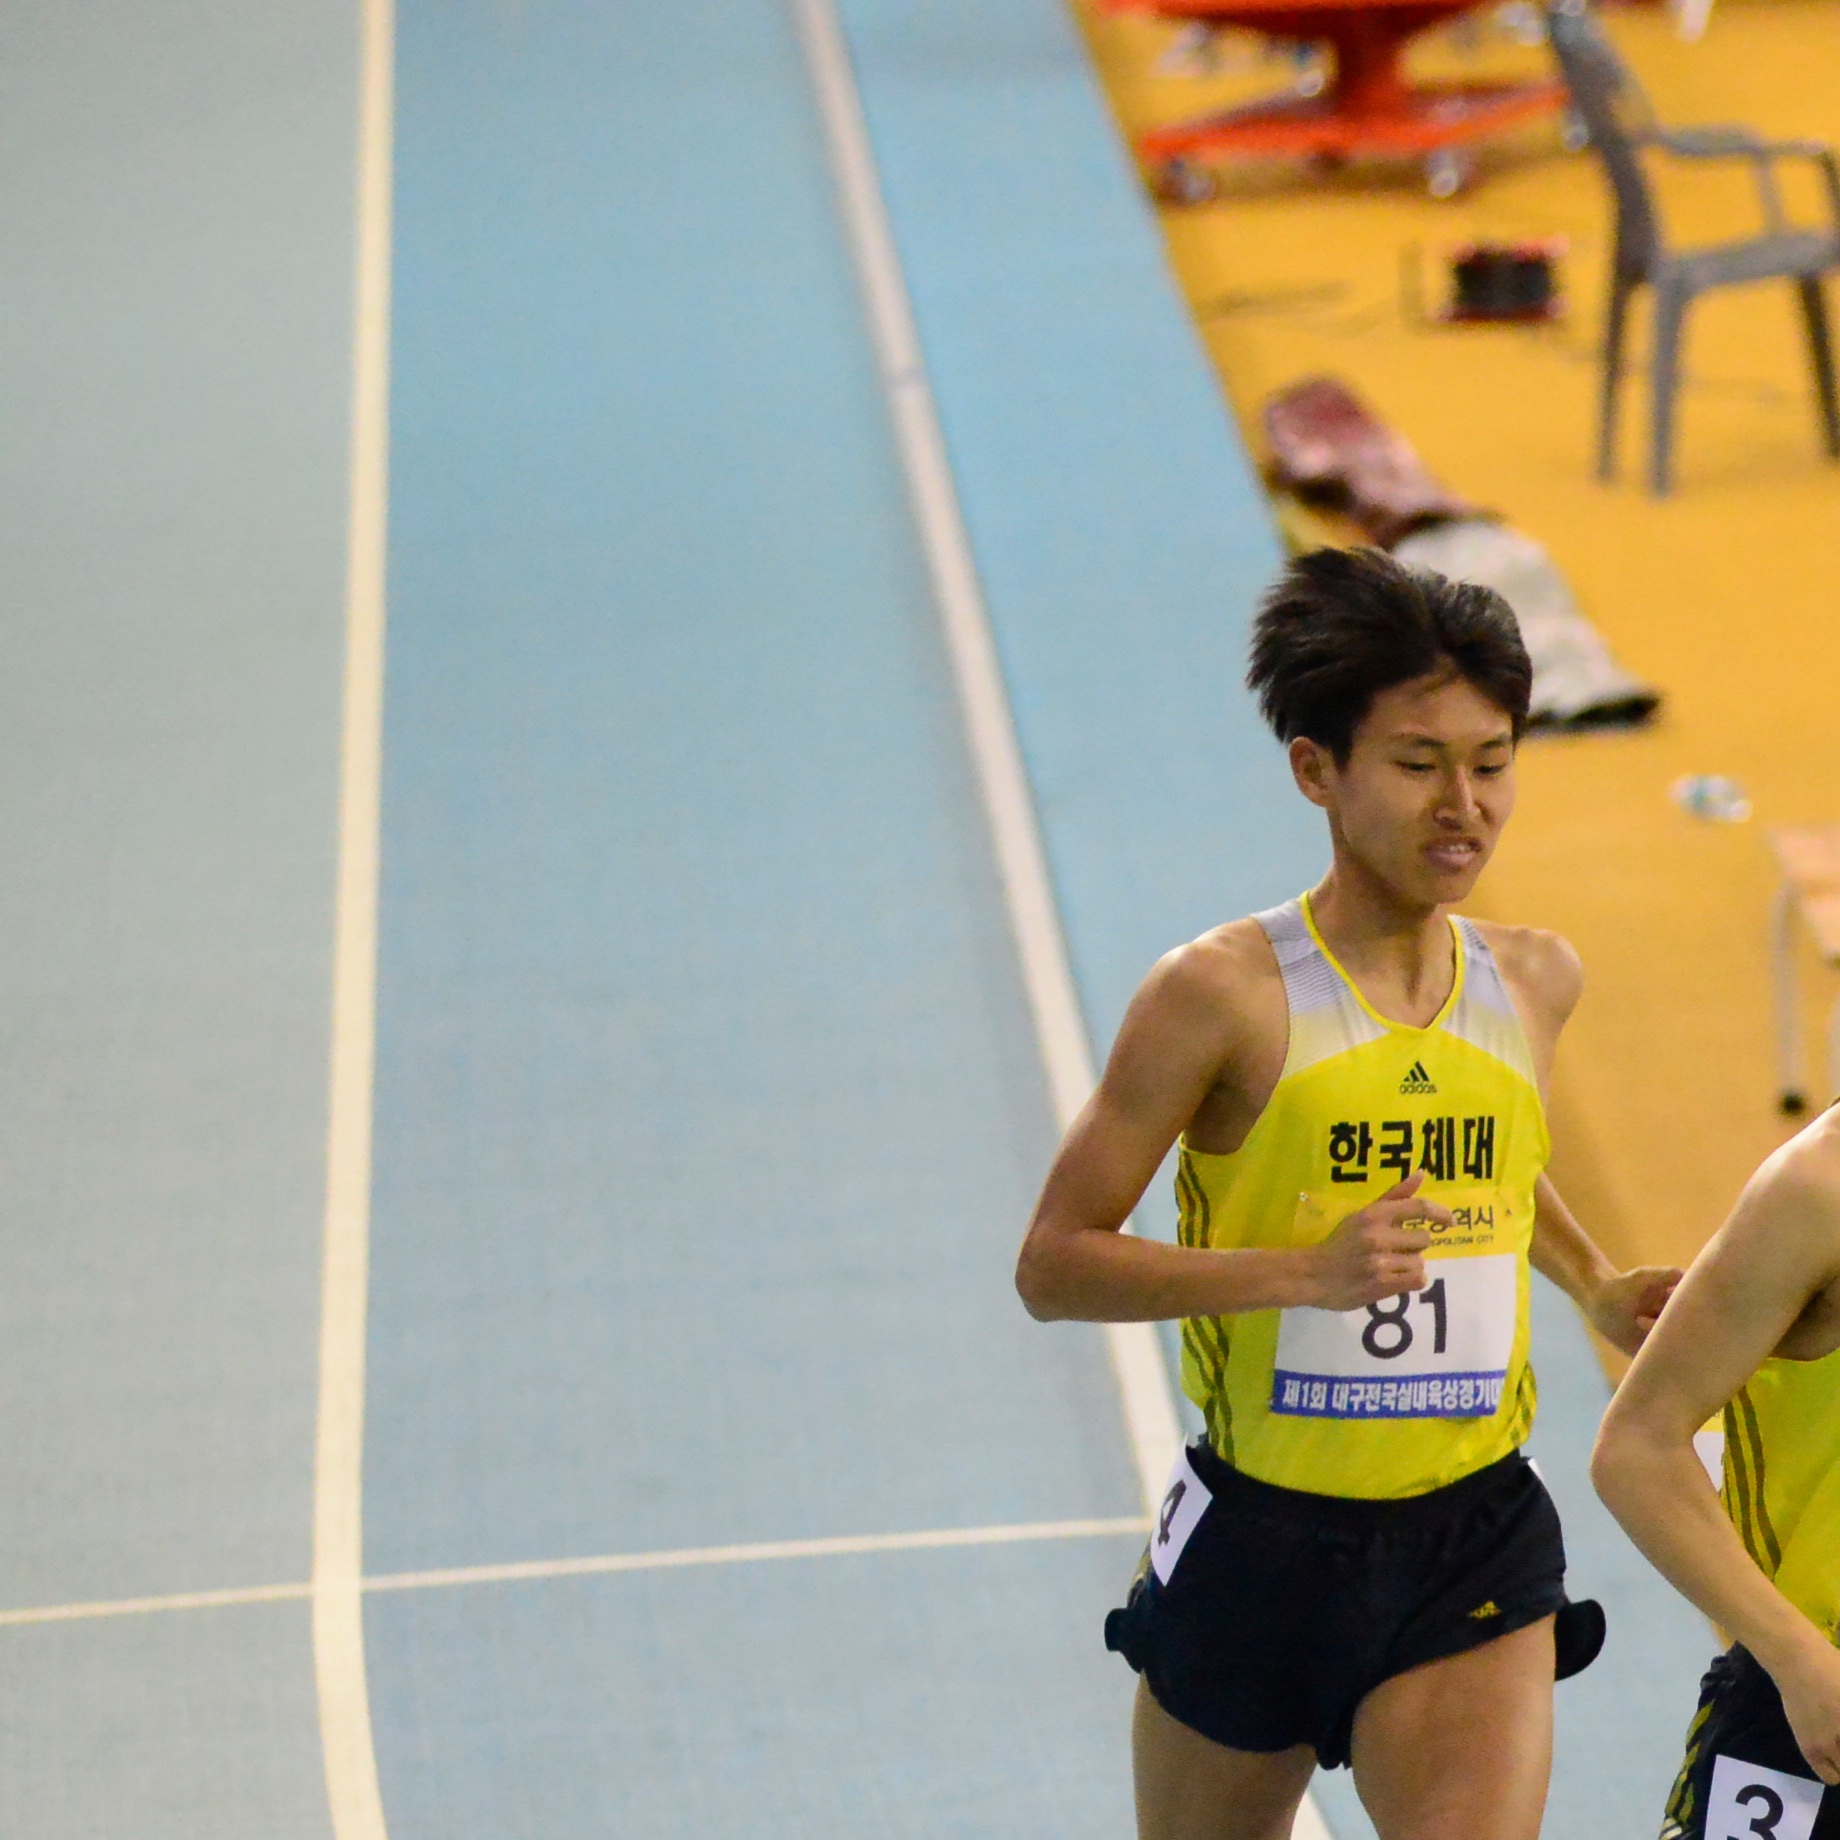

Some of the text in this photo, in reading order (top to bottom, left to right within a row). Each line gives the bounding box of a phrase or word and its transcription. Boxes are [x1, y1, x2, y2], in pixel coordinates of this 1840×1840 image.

[1329, 1115, 1494, 1182] 한국체대
[1361, 1278, 1447, 1359] 81
[1282, 1379, 1327, 1411] 제1회
